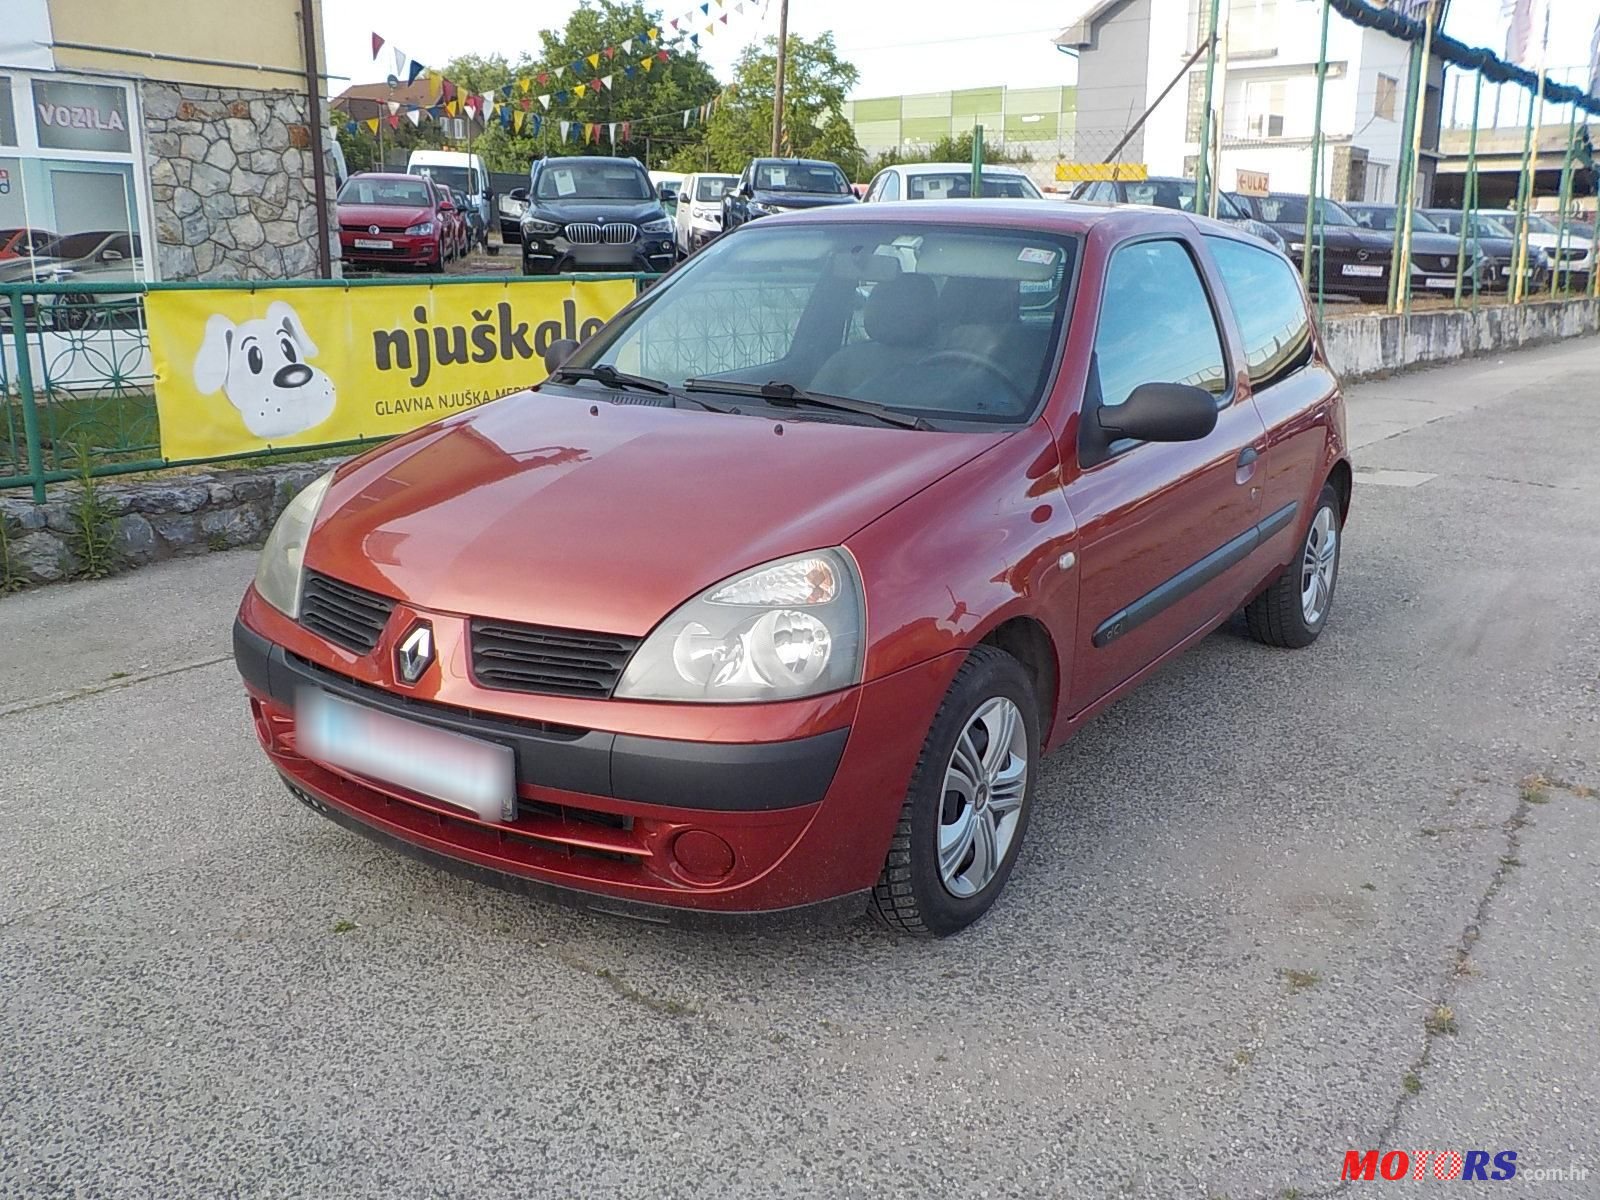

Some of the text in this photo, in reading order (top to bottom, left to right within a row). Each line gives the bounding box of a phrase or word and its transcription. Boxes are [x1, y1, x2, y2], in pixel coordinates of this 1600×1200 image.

[38, 103, 124, 131] VOZILA
[1247, 175, 1268, 191] ULAZ
[376, 396, 433, 415] GLAVNA
[438, 388, 490, 409] NJUŠKA
